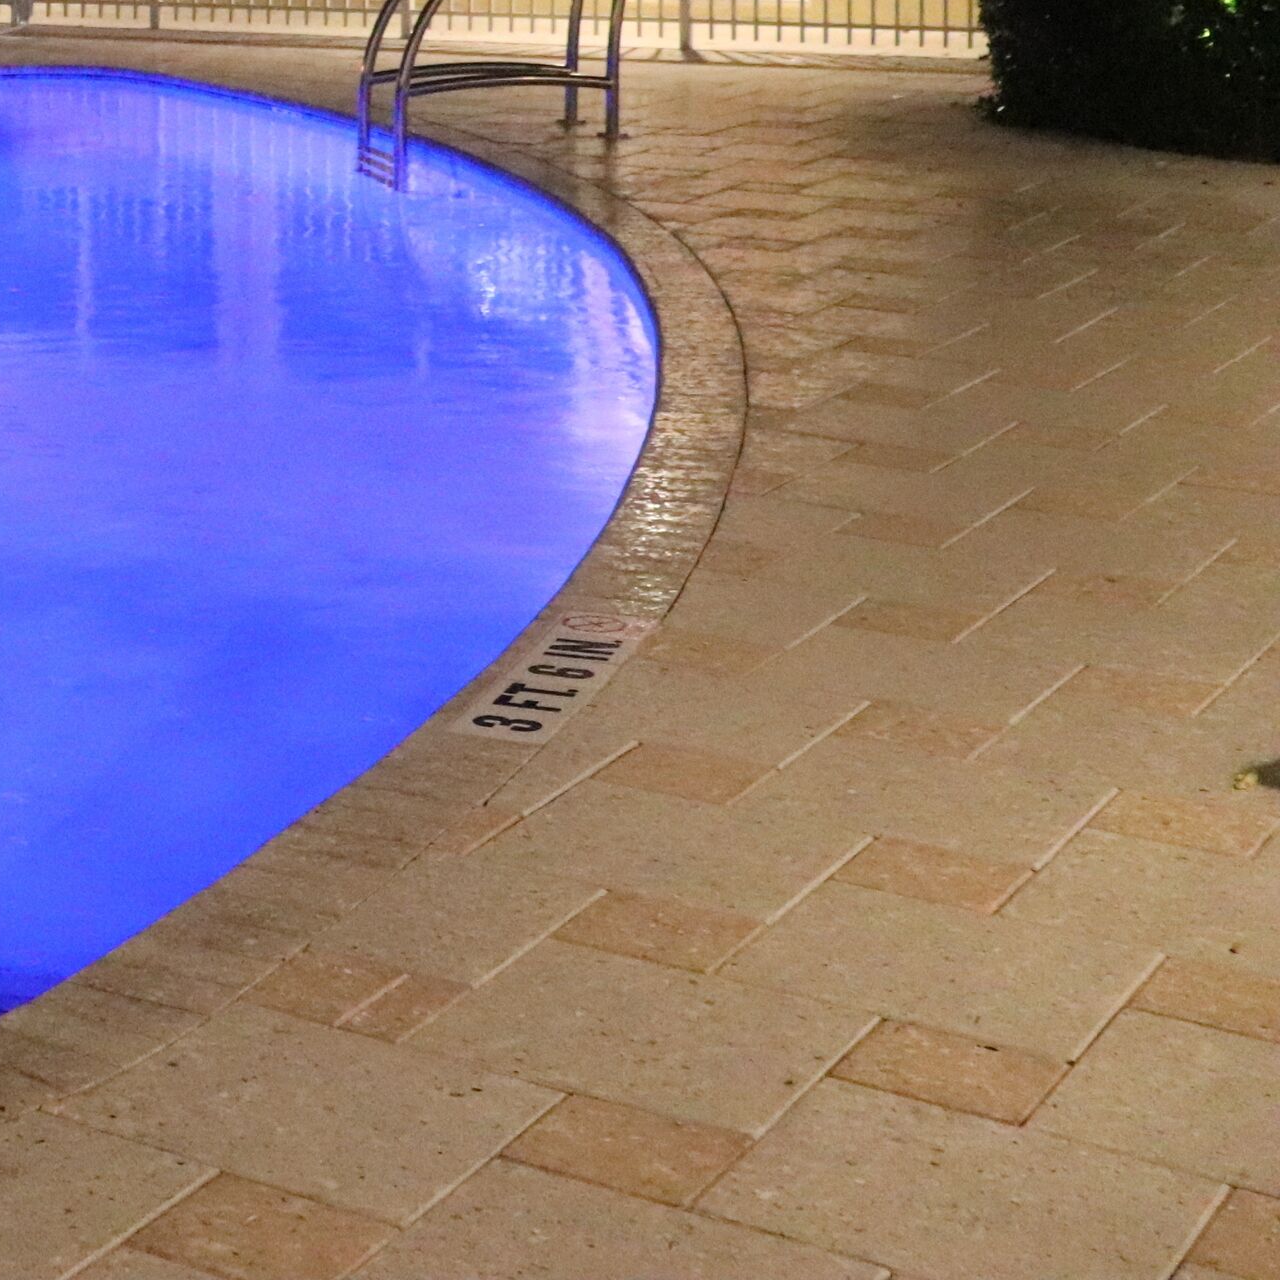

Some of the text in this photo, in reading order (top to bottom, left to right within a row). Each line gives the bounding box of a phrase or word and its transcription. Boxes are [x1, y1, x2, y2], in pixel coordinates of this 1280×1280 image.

[472, 638, 623, 732] 3 FT. 6 IN.
